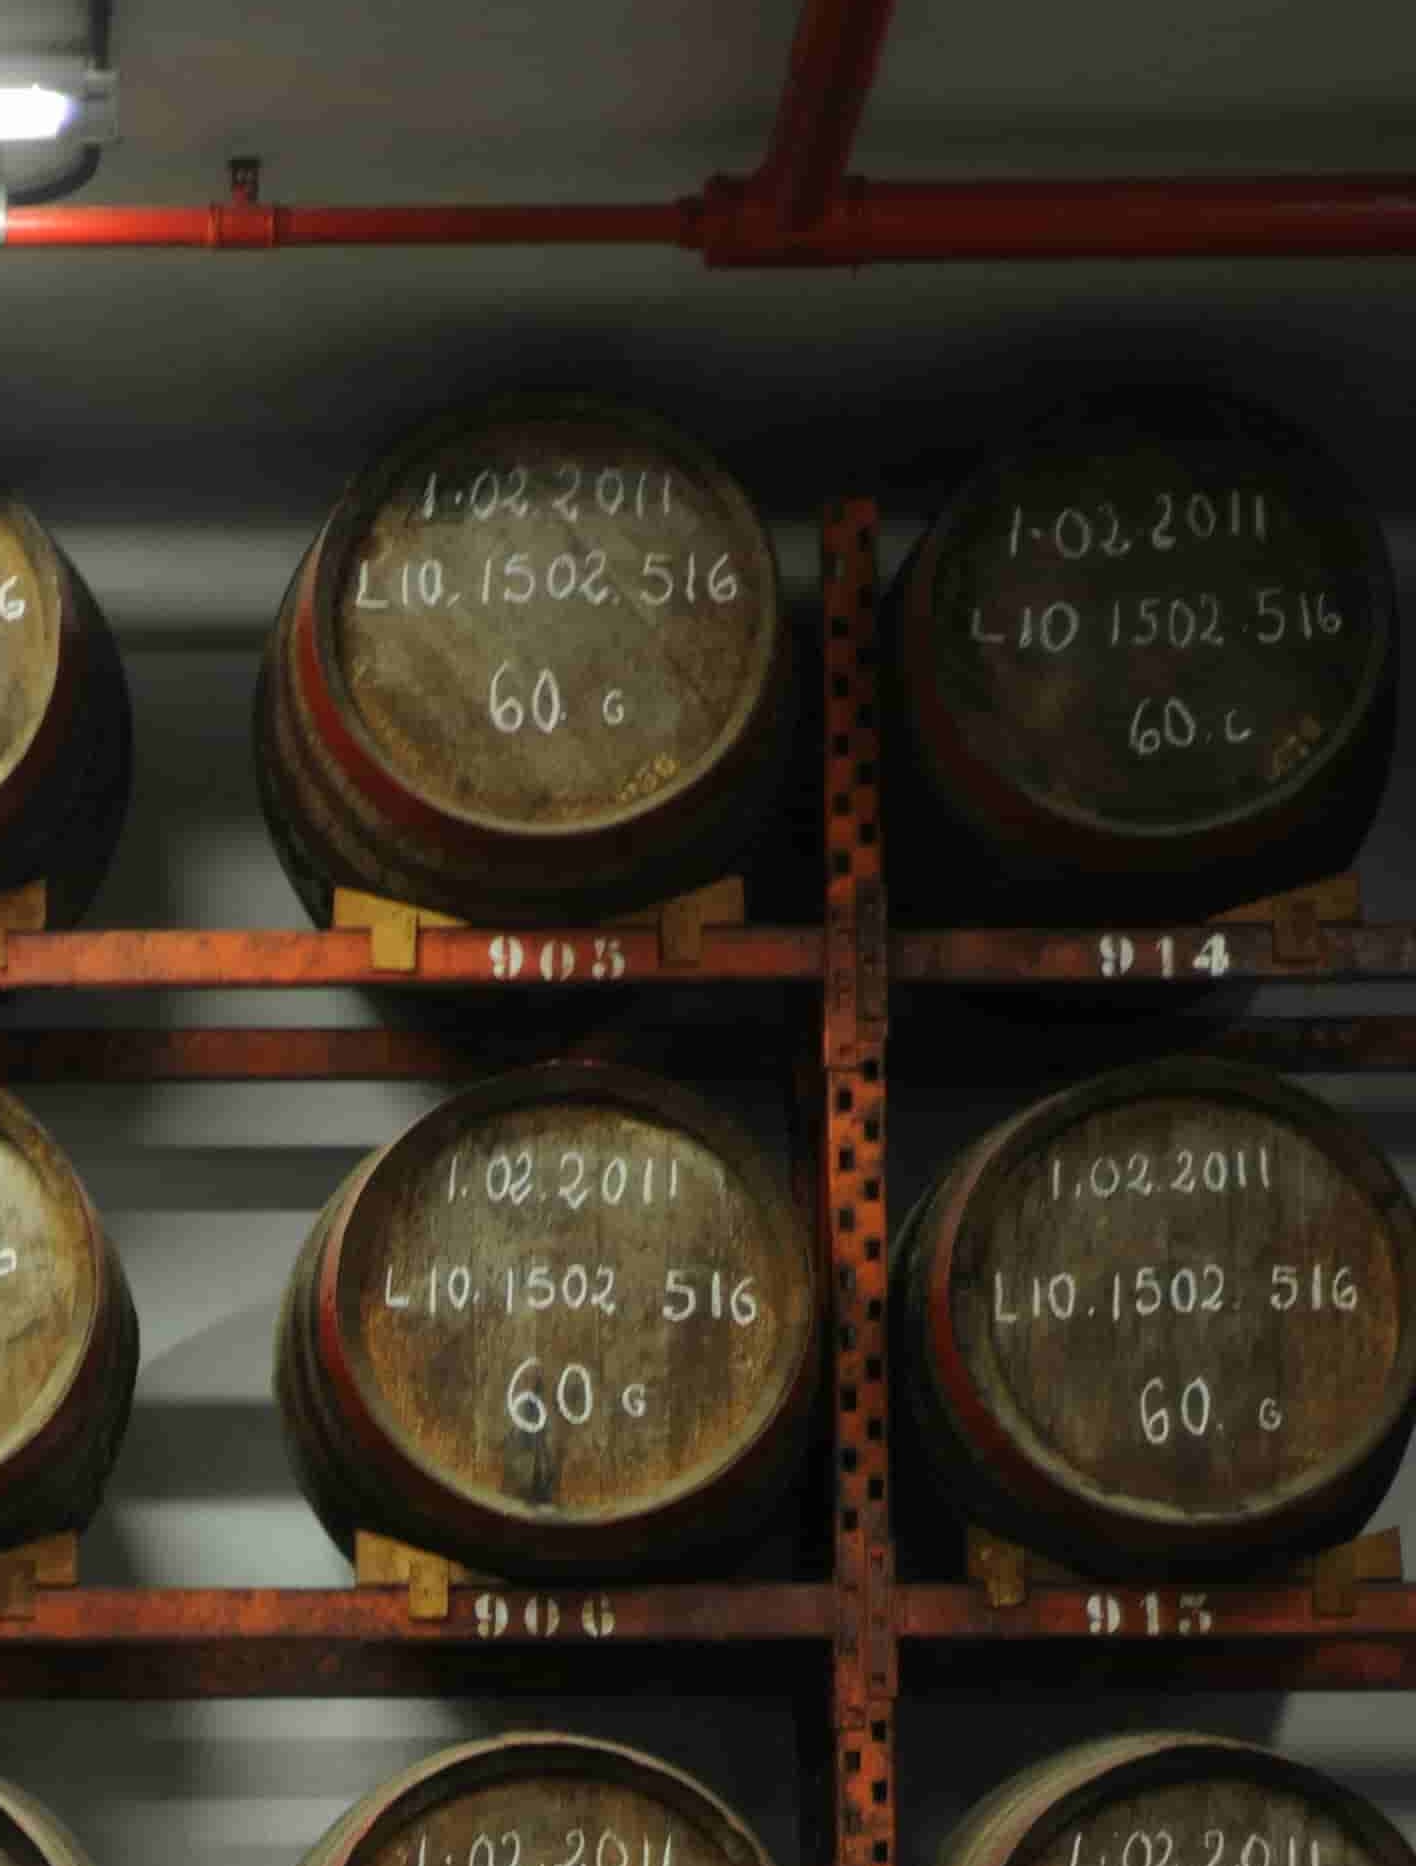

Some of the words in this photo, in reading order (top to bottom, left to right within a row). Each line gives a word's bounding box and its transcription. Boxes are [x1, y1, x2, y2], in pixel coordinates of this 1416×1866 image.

[488, 934, 626, 981] 905
[1098, 932, 1230, 979] 914
[473, 1592, 616, 1639] 906
